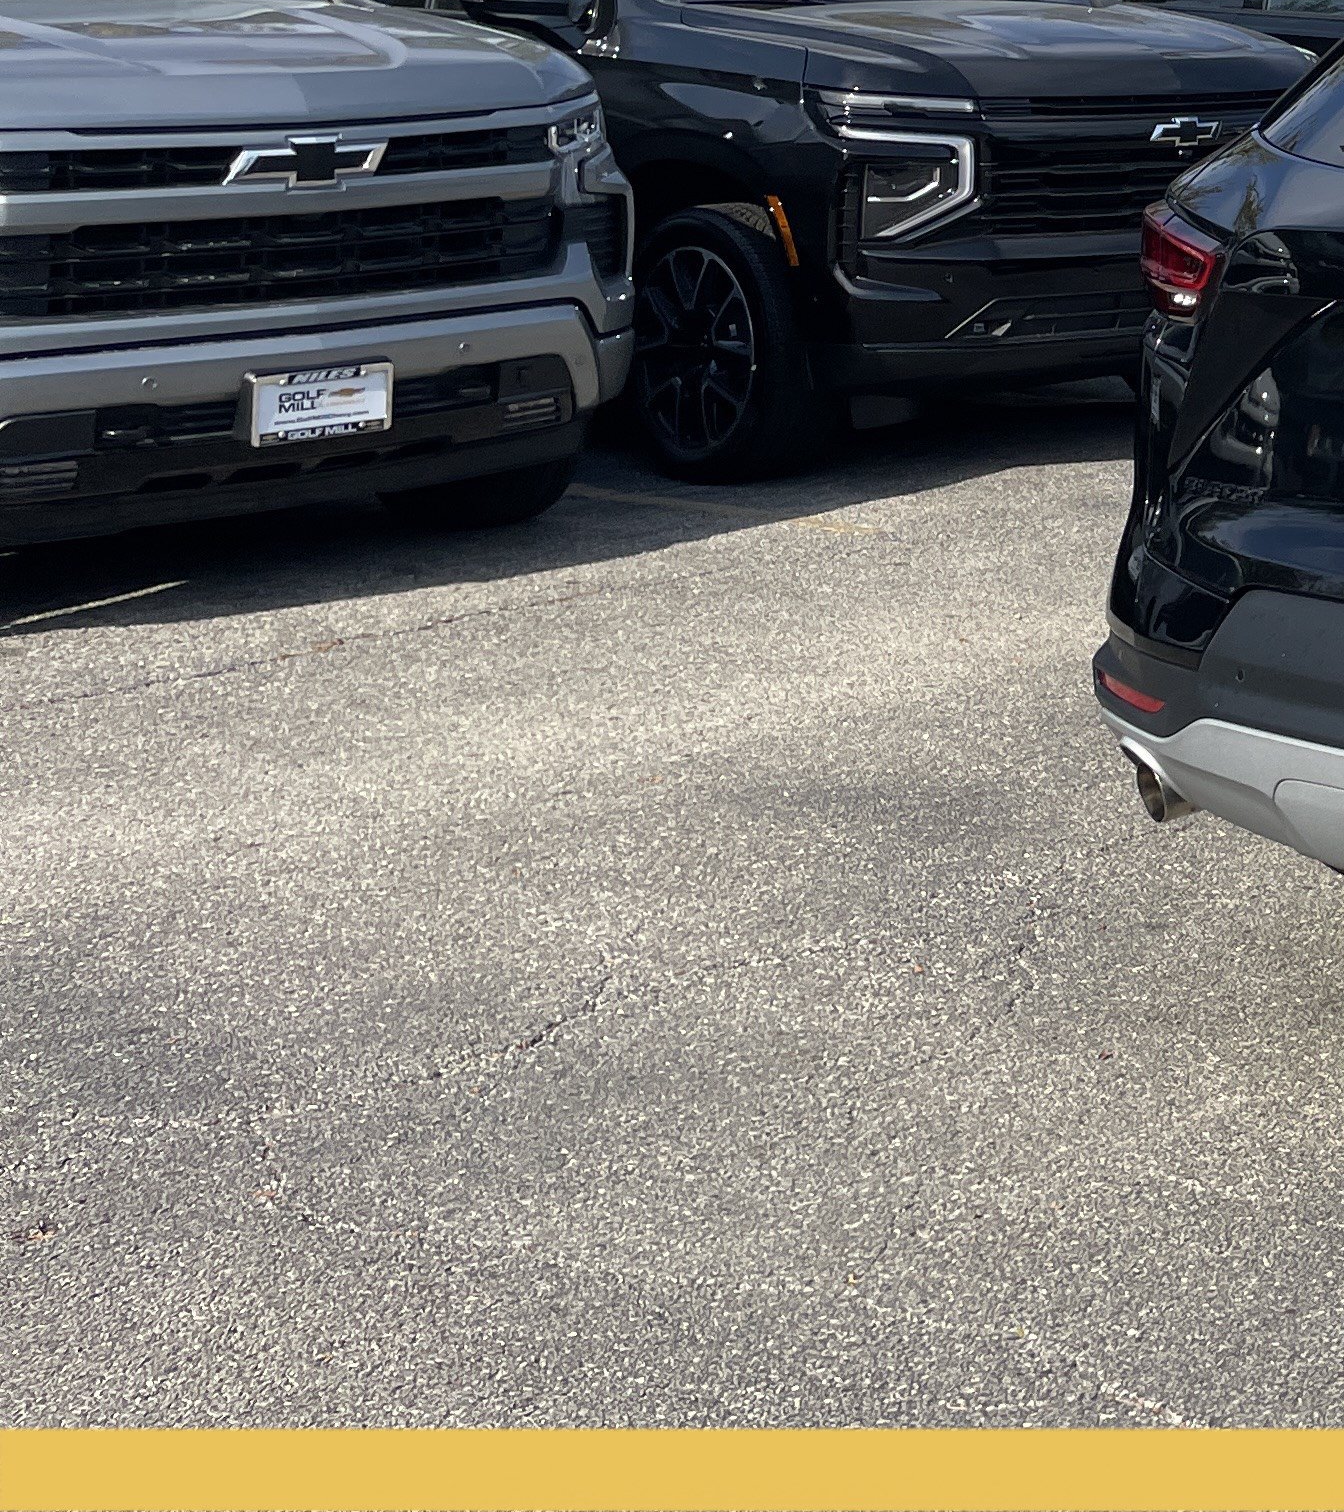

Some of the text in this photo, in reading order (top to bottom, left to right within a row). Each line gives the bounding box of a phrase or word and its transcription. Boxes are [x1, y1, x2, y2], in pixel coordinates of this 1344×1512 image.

[291, 367, 357, 384] NILES
[278, 389, 326, 403] GOLF
[278, 400, 317, 414] MILL
